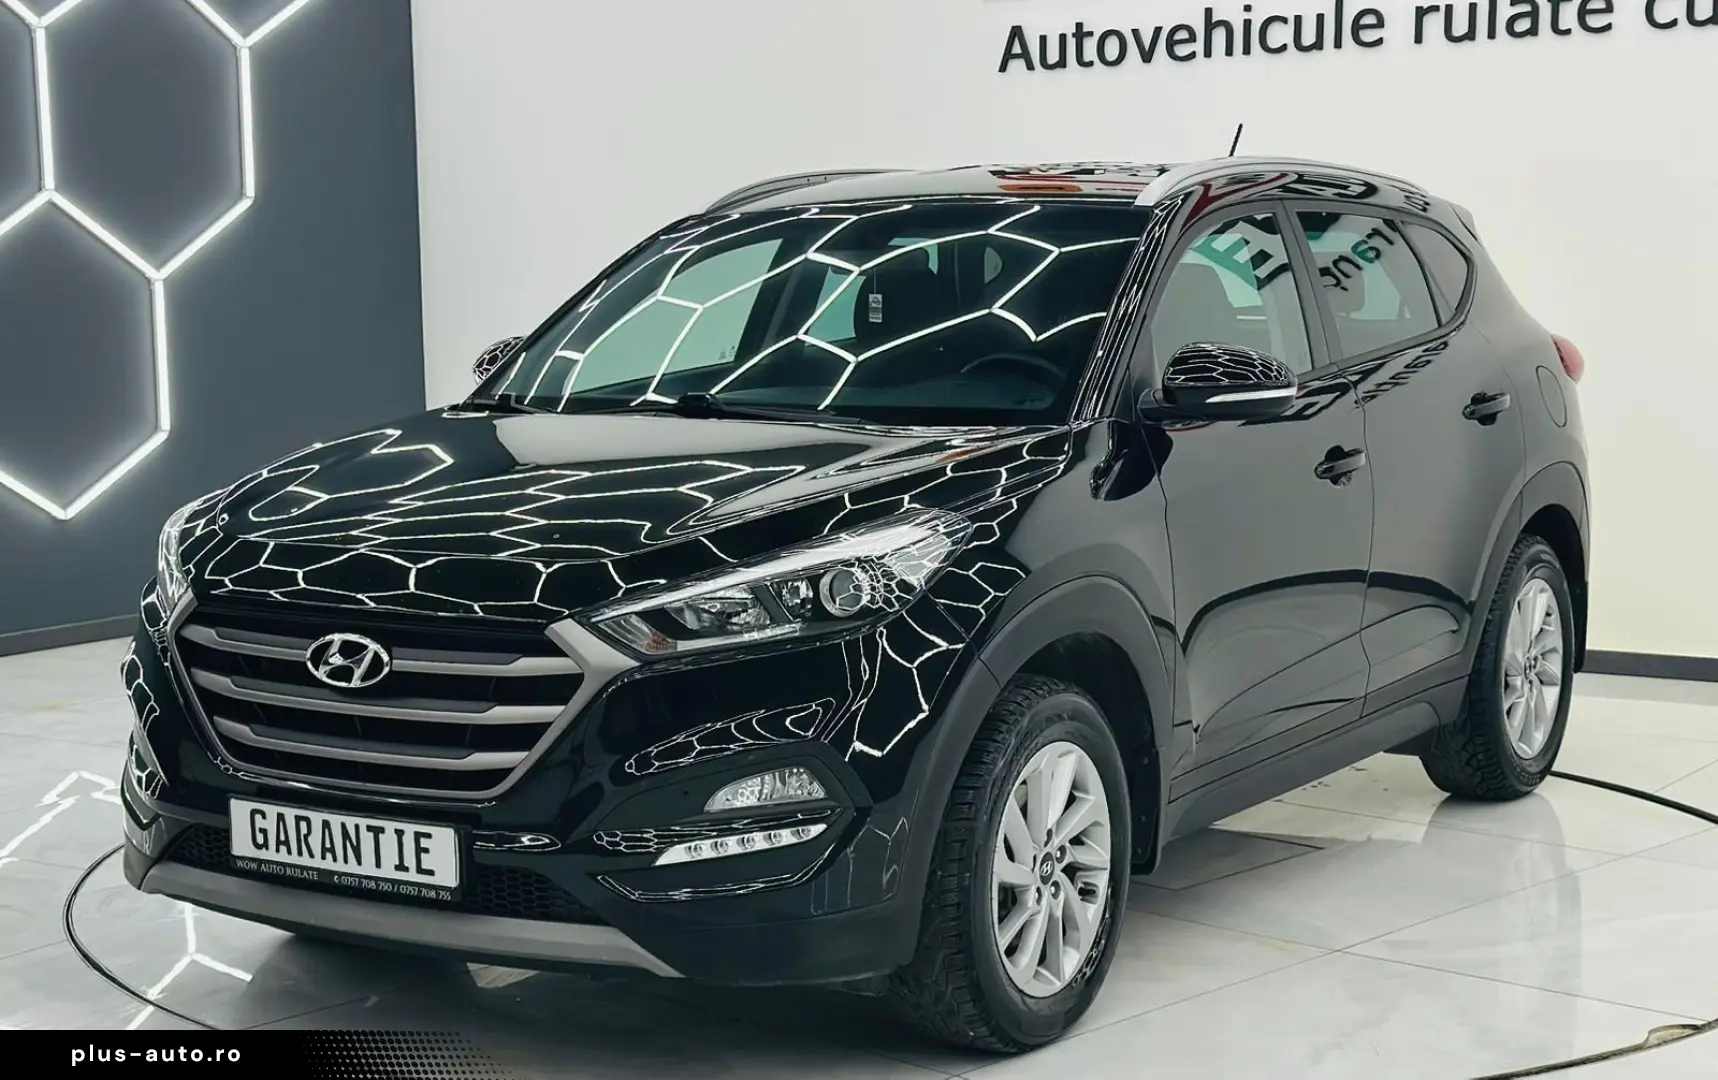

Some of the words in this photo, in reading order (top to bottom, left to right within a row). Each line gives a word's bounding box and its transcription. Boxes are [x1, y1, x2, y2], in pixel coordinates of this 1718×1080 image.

[998, 0, 1385, 73] Autovehicule
[1413, 0, 1615, 45] rulate
[250, 808, 436, 877] GARANTIE
[236, 859, 258, 871] WOW
[260, 863, 285, 875] AUTO
[286, 867, 319, 880] RULATE
[341, 876, 360, 888] 0757
[362, 879, 377, 890] 708
[400, 884, 419, 897] 0757
[420, 887, 437, 899] 708
[438, 890, 452, 901] 755
